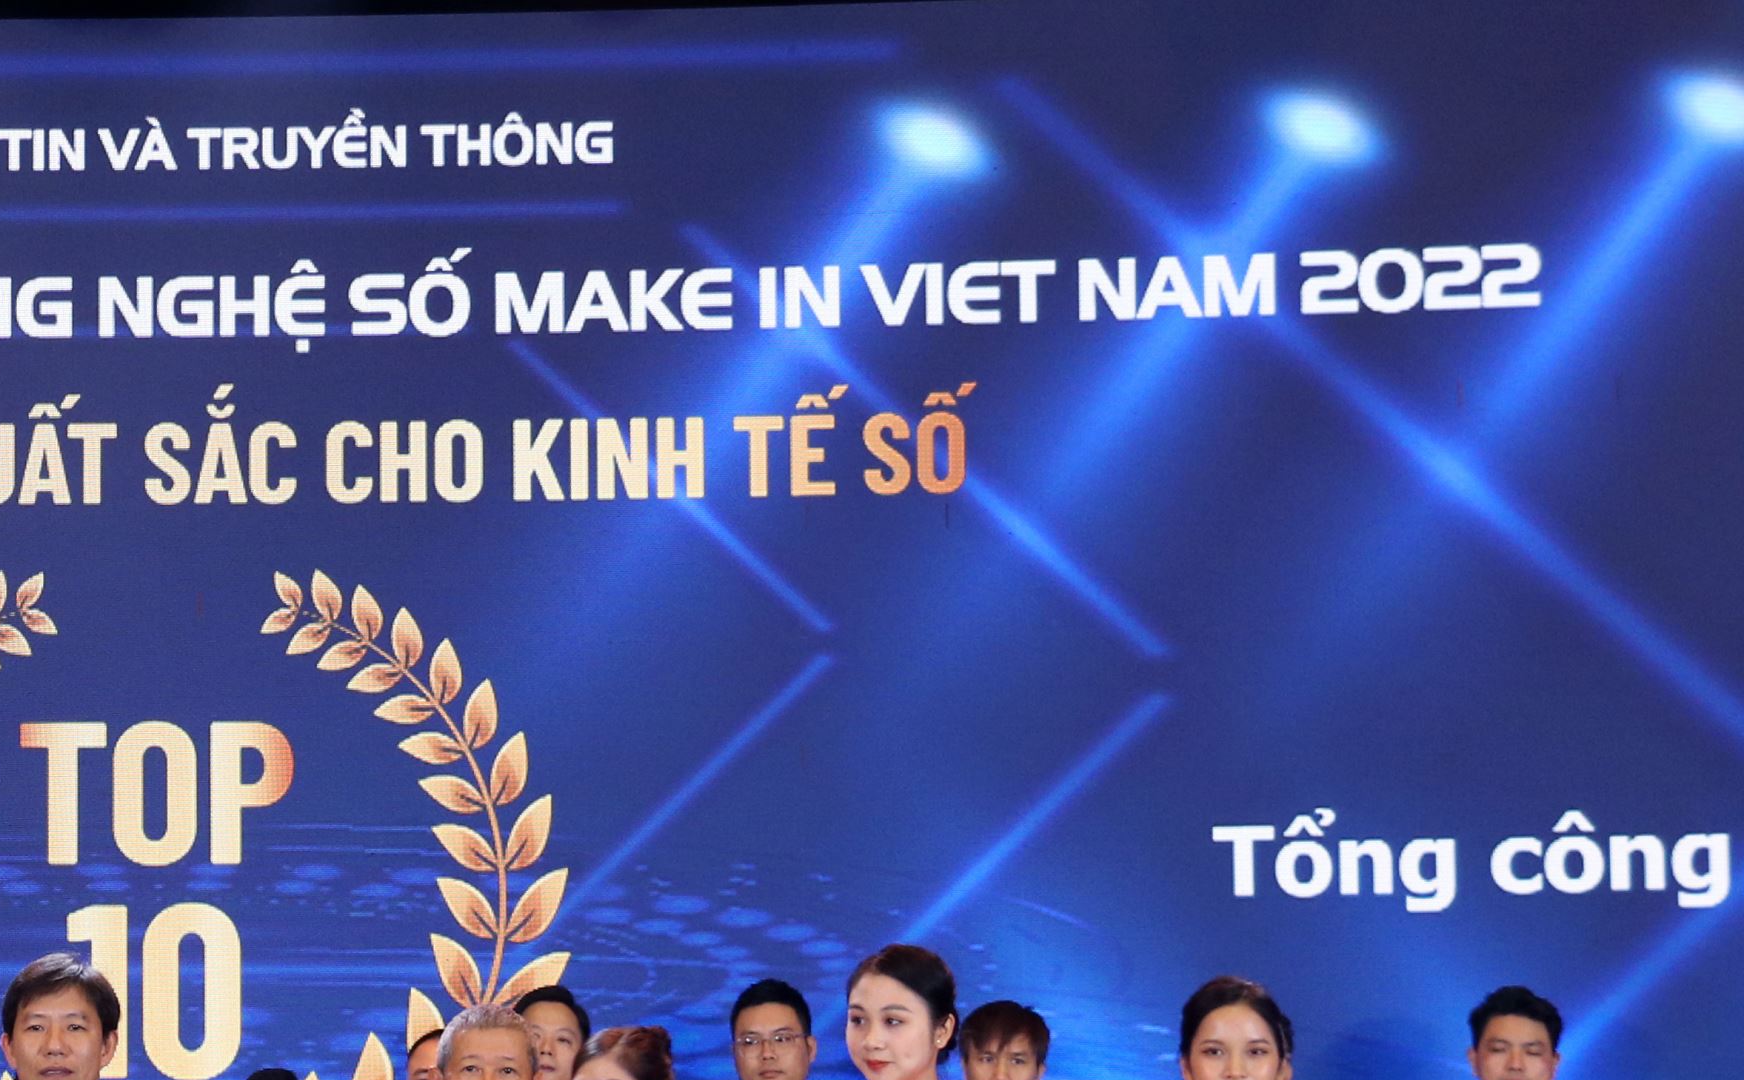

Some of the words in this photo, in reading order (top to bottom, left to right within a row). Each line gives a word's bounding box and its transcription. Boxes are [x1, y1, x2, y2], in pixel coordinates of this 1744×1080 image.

[98, 117, 178, 172] VÀ
[187, 108, 408, 171] TRUYỀN
[421, 112, 615, 168] THÔNG
[99, 260, 327, 354] NGHỆ
[349, 248, 473, 339] SỐ
[495, 268, 734, 335] MAKE
[759, 265, 842, 330] IN
[860, 260, 1057, 327] VIET
[1079, 253, 1277, 322] NAM
[1300, 243, 1544, 316] 2022
[145, 384, 298, 507] SẮC
[326, 420, 485, 505] CHO
[513, 417, 706, 503] KINH
[735, 384, 848, 498] TẾ
[863, 382, 978, 496] SỐ
[20, 721, 295, 868] TOP
[1213, 808, 1458, 914] Tổng
[1491, 811, 1732, 909] công
